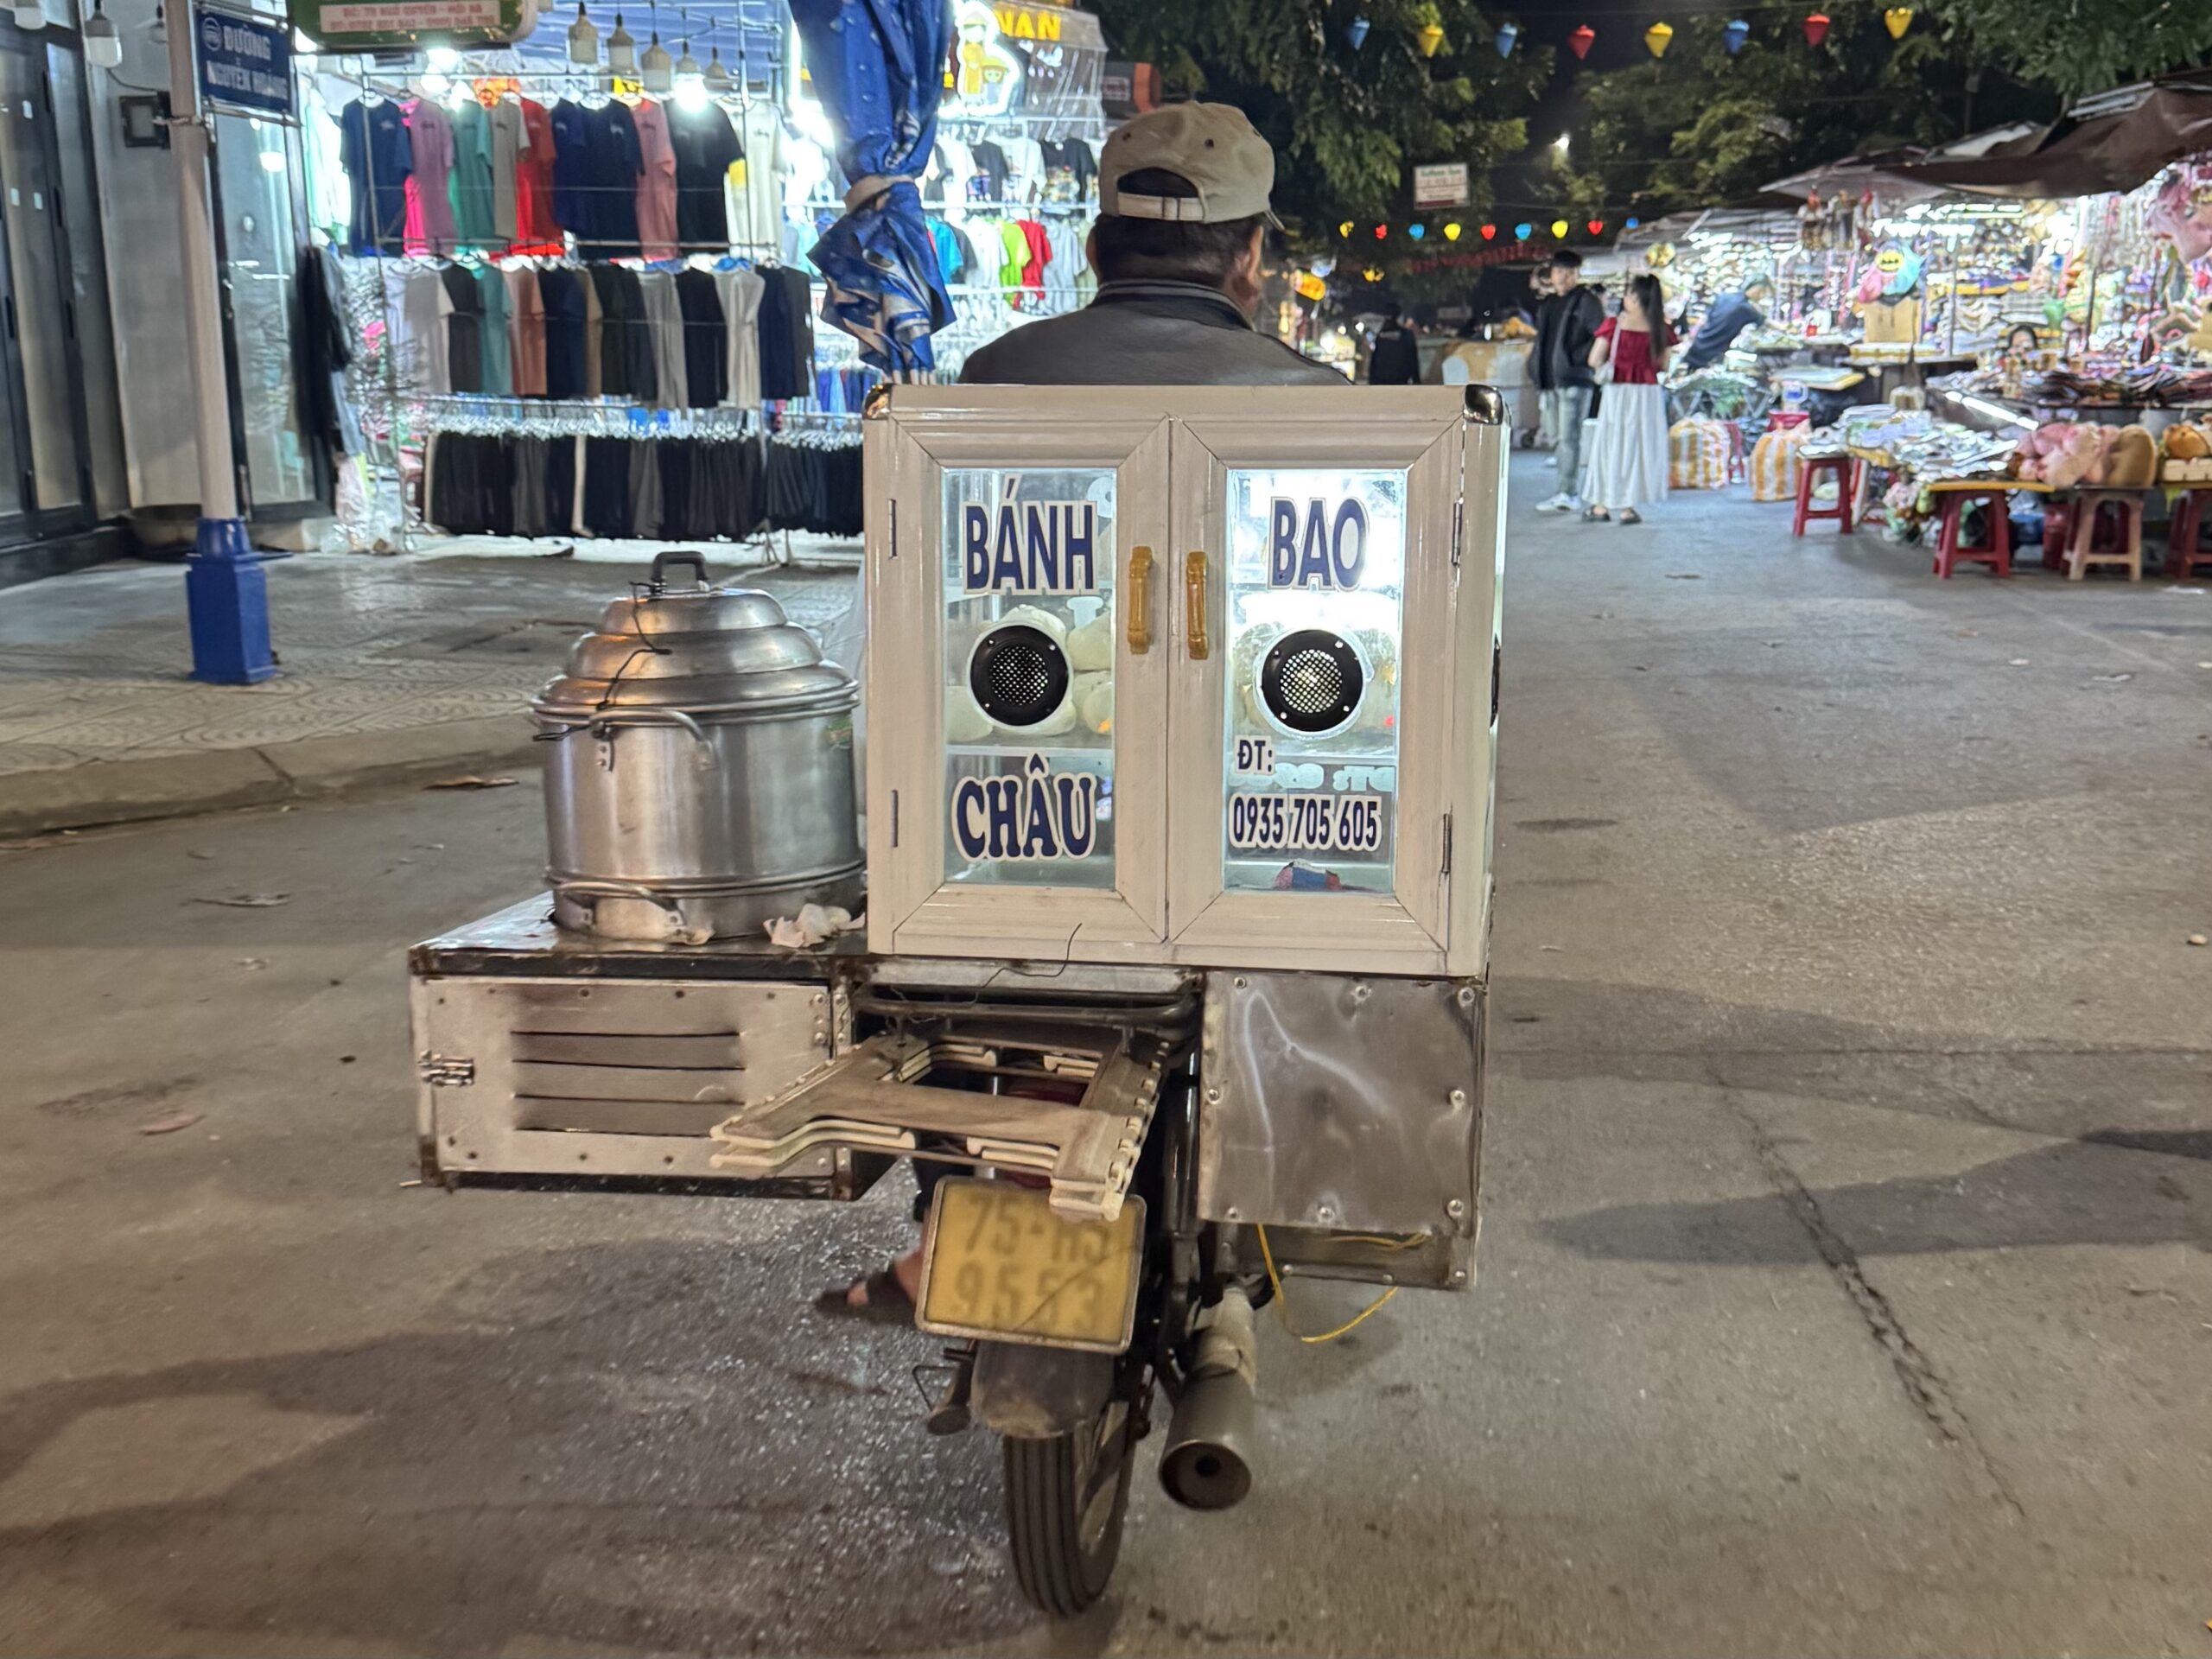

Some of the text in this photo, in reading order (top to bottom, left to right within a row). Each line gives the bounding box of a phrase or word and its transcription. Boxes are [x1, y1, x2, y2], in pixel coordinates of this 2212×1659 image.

[964, 477, 1363, 590] BÁNH BAO
[1237, 740, 1273, 772] ĐT:
[957, 753, 1092, 857] CHÂU
[1233, 796, 1378, 848] 0935 705 605
